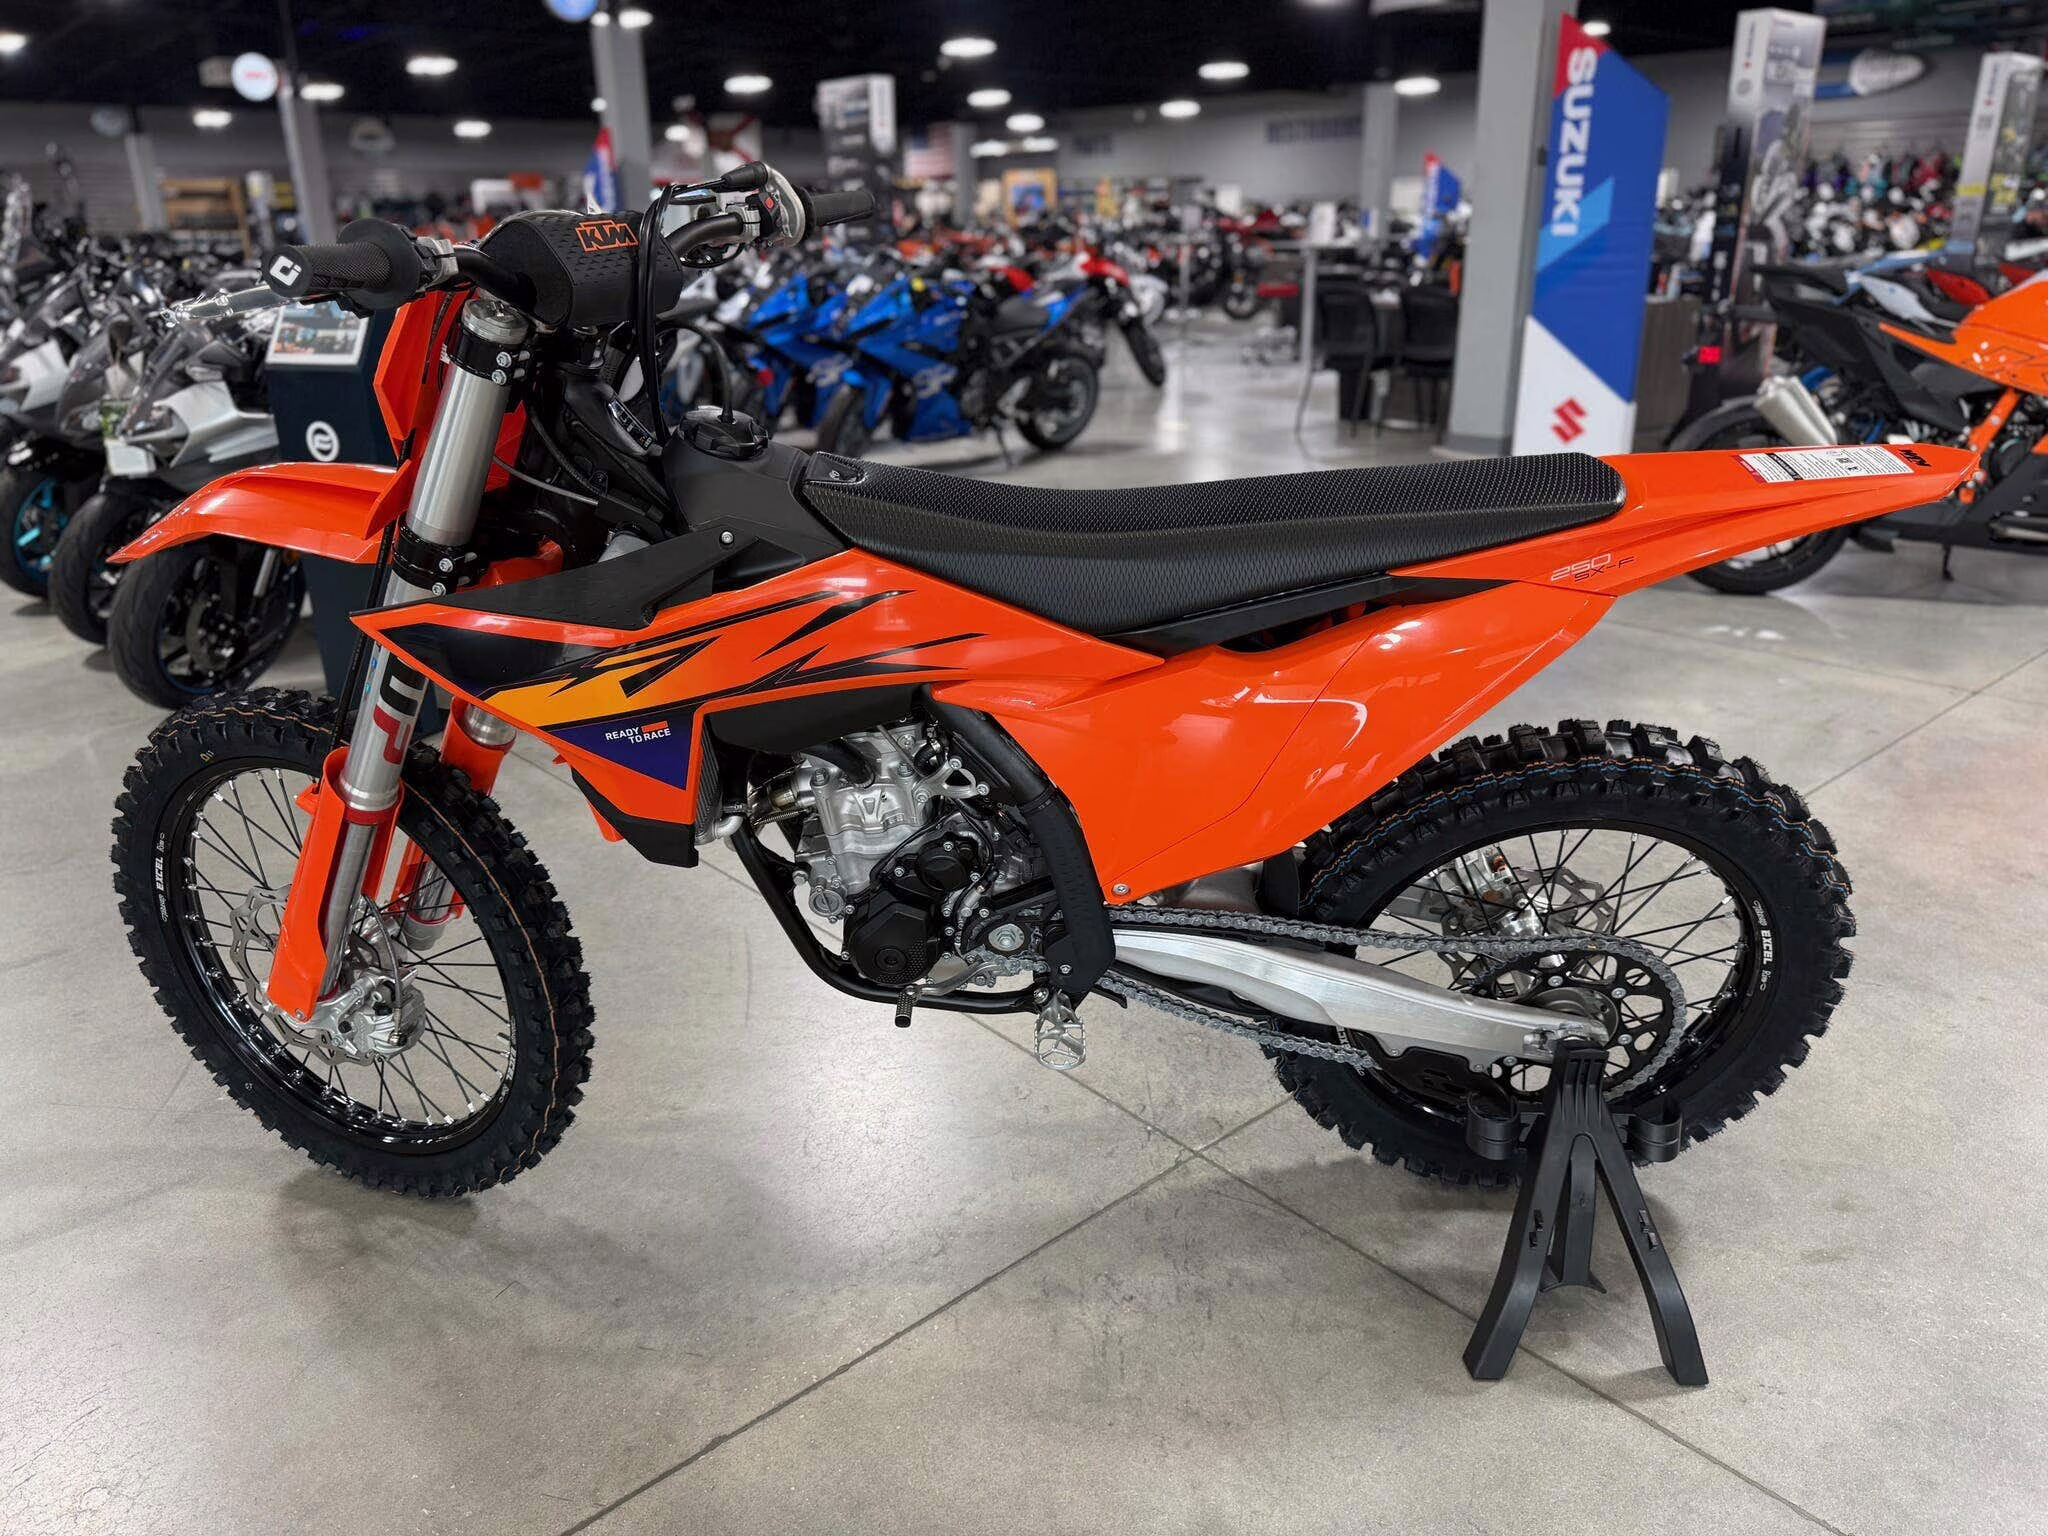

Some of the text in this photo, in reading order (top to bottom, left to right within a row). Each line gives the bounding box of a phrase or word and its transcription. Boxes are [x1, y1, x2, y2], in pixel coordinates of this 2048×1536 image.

[1551, 47, 1598, 237] SUZUKI
[576, 220, 639, 252] KTM
[1899, 449, 1931, 467] KTM
[1551, 553, 1611, 582] 250
[1574, 556, 1635, 582] SX-F
[605, 726, 640, 741] READY
[627, 728, 671, 744] TO RACE
[155, 857, 164, 891] EXCEL
[1761, 929, 1773, 965] EXCEL
